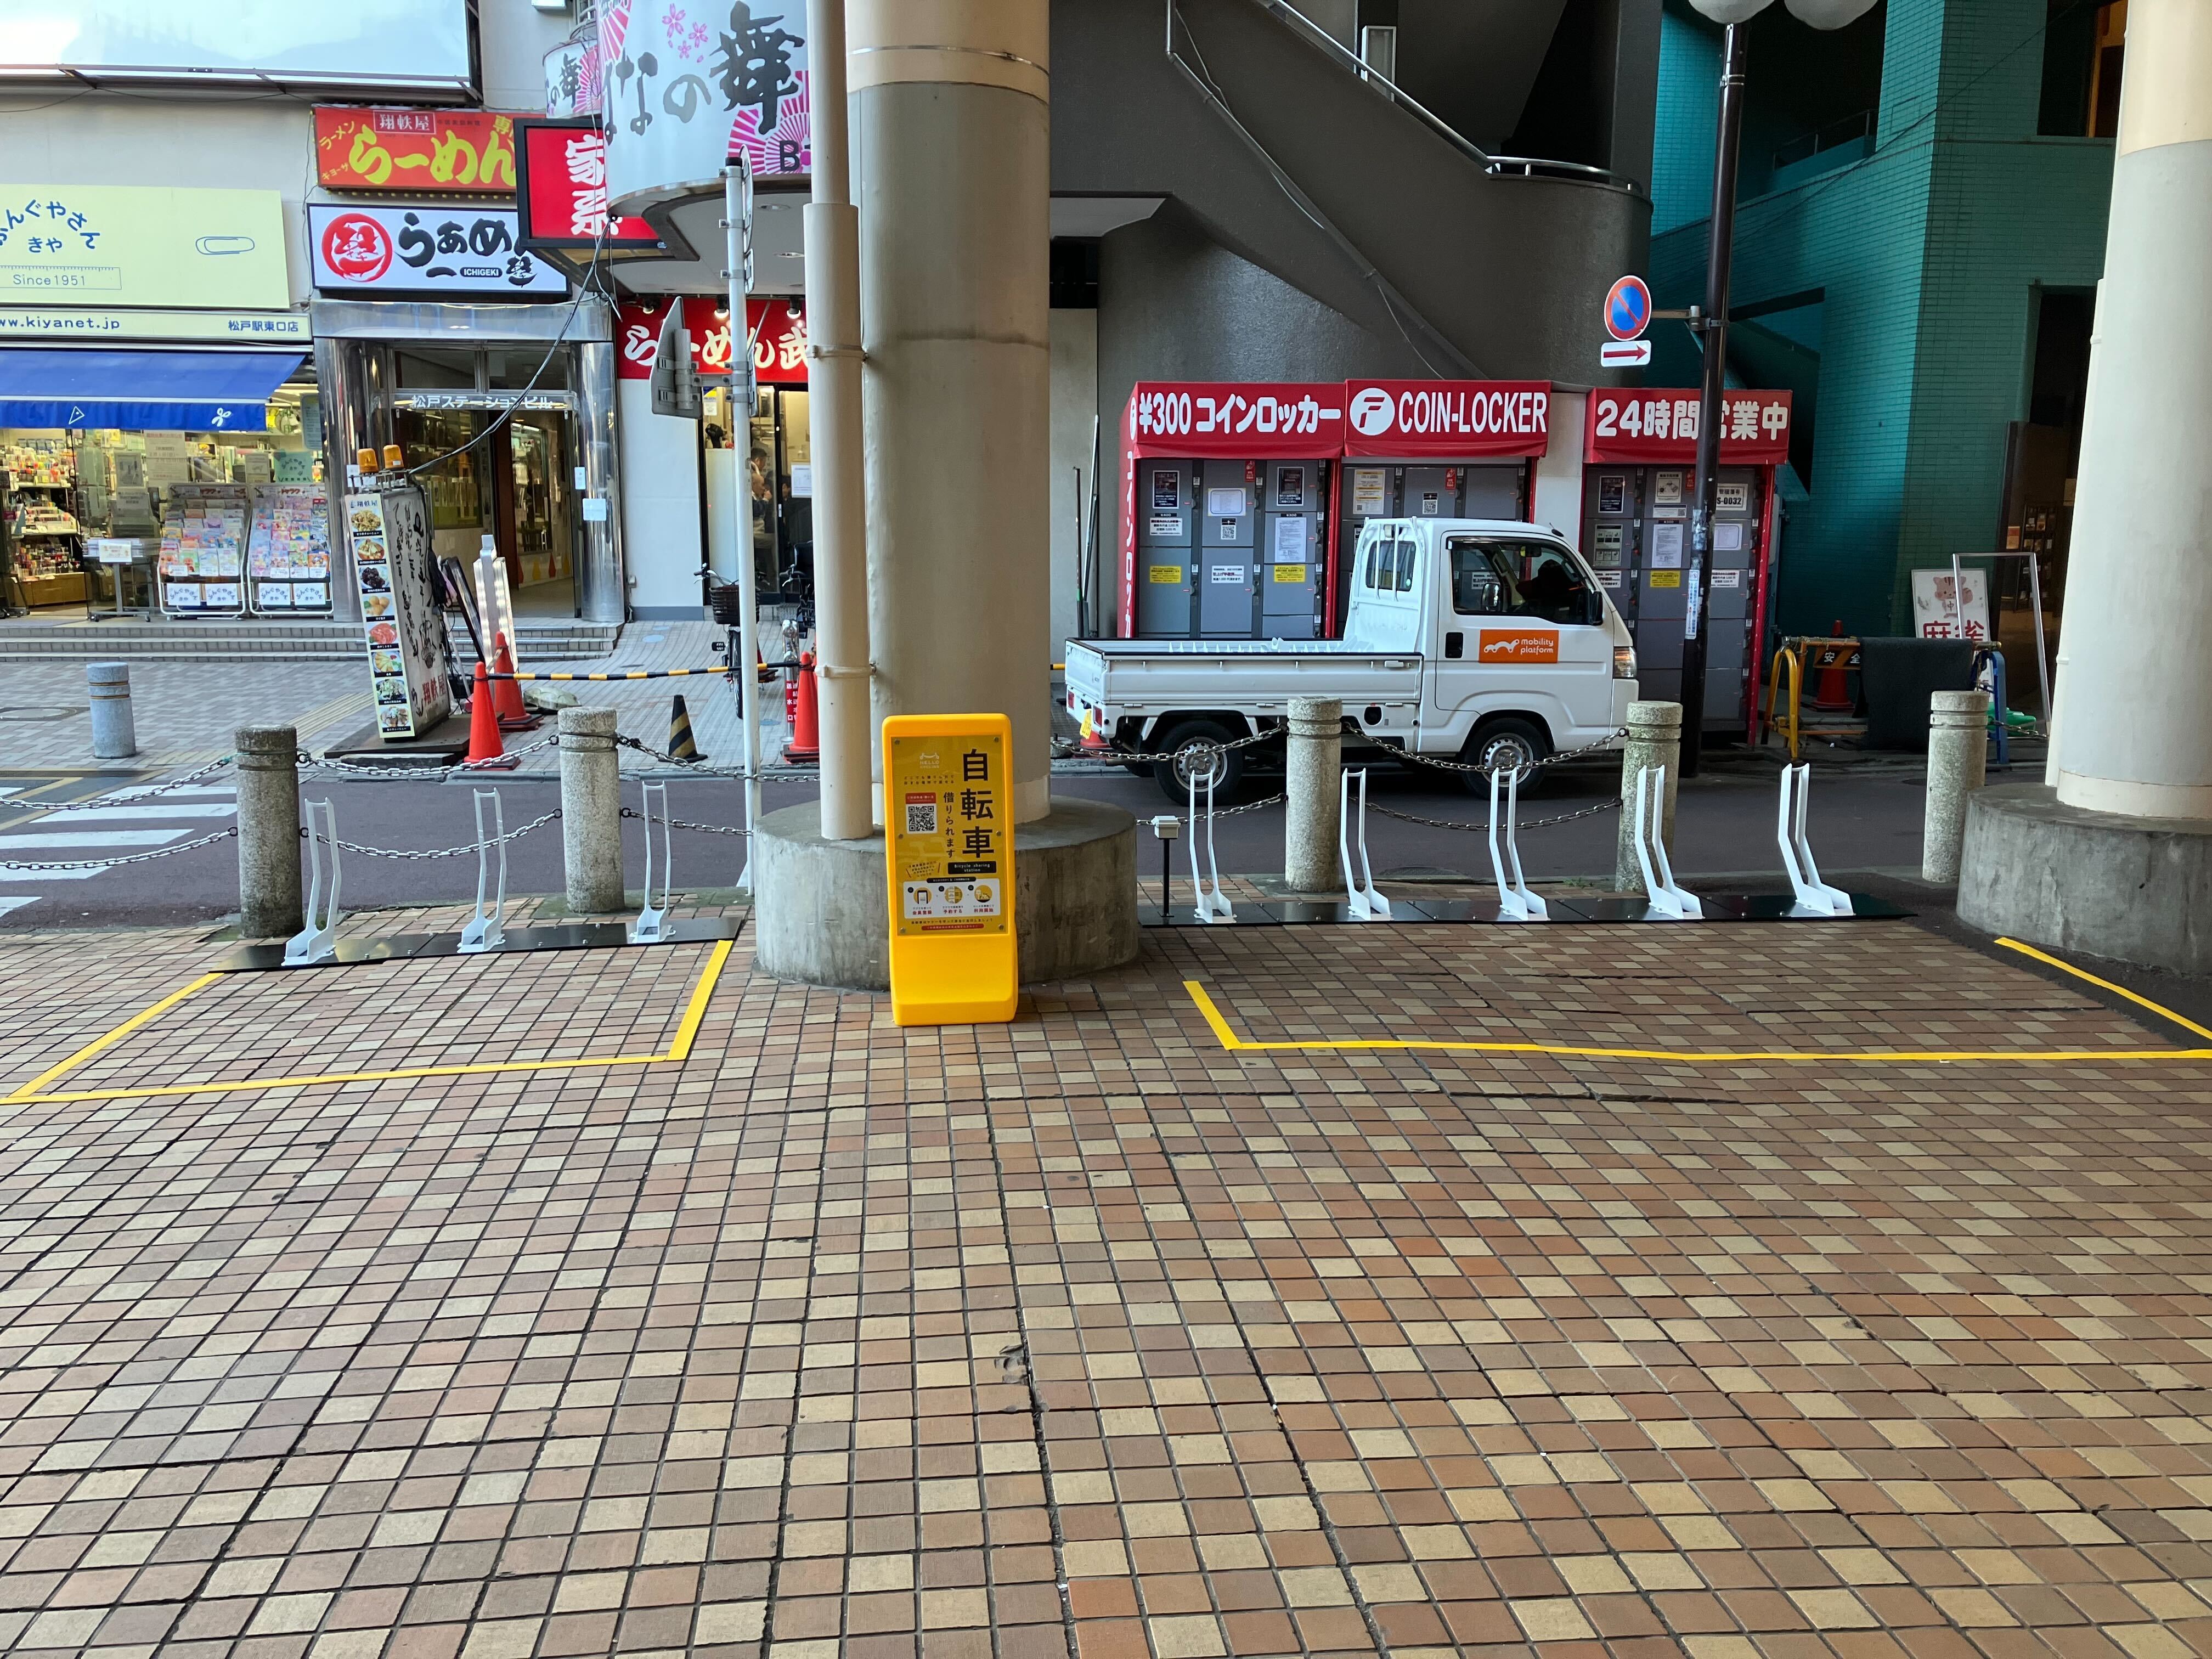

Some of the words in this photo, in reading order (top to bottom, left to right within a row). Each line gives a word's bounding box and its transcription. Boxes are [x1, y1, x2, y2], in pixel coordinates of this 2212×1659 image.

[319, 120, 355, 150] ラーメン
[348, 123, 517, 184] らーめん
[28, 236, 63, 253] きや
[464, 268, 499, 276] ICHIGEKI
[228, 320, 299, 332] 松戸駅東口店
[624, 325, 808, 370] らめん武
[411, 394, 553, 409] 松戸ステーションビル
[1195, 393, 1342, 434] コインロッカー
[1398, 391, 1547, 436] COIN-LOCKER
[1520, 646, 1554, 655] platform
[1521, 637, 1554, 646] mobility
[960, 748, 994, 859] 自転車
[943, 792, 956, 858] 借りられます
